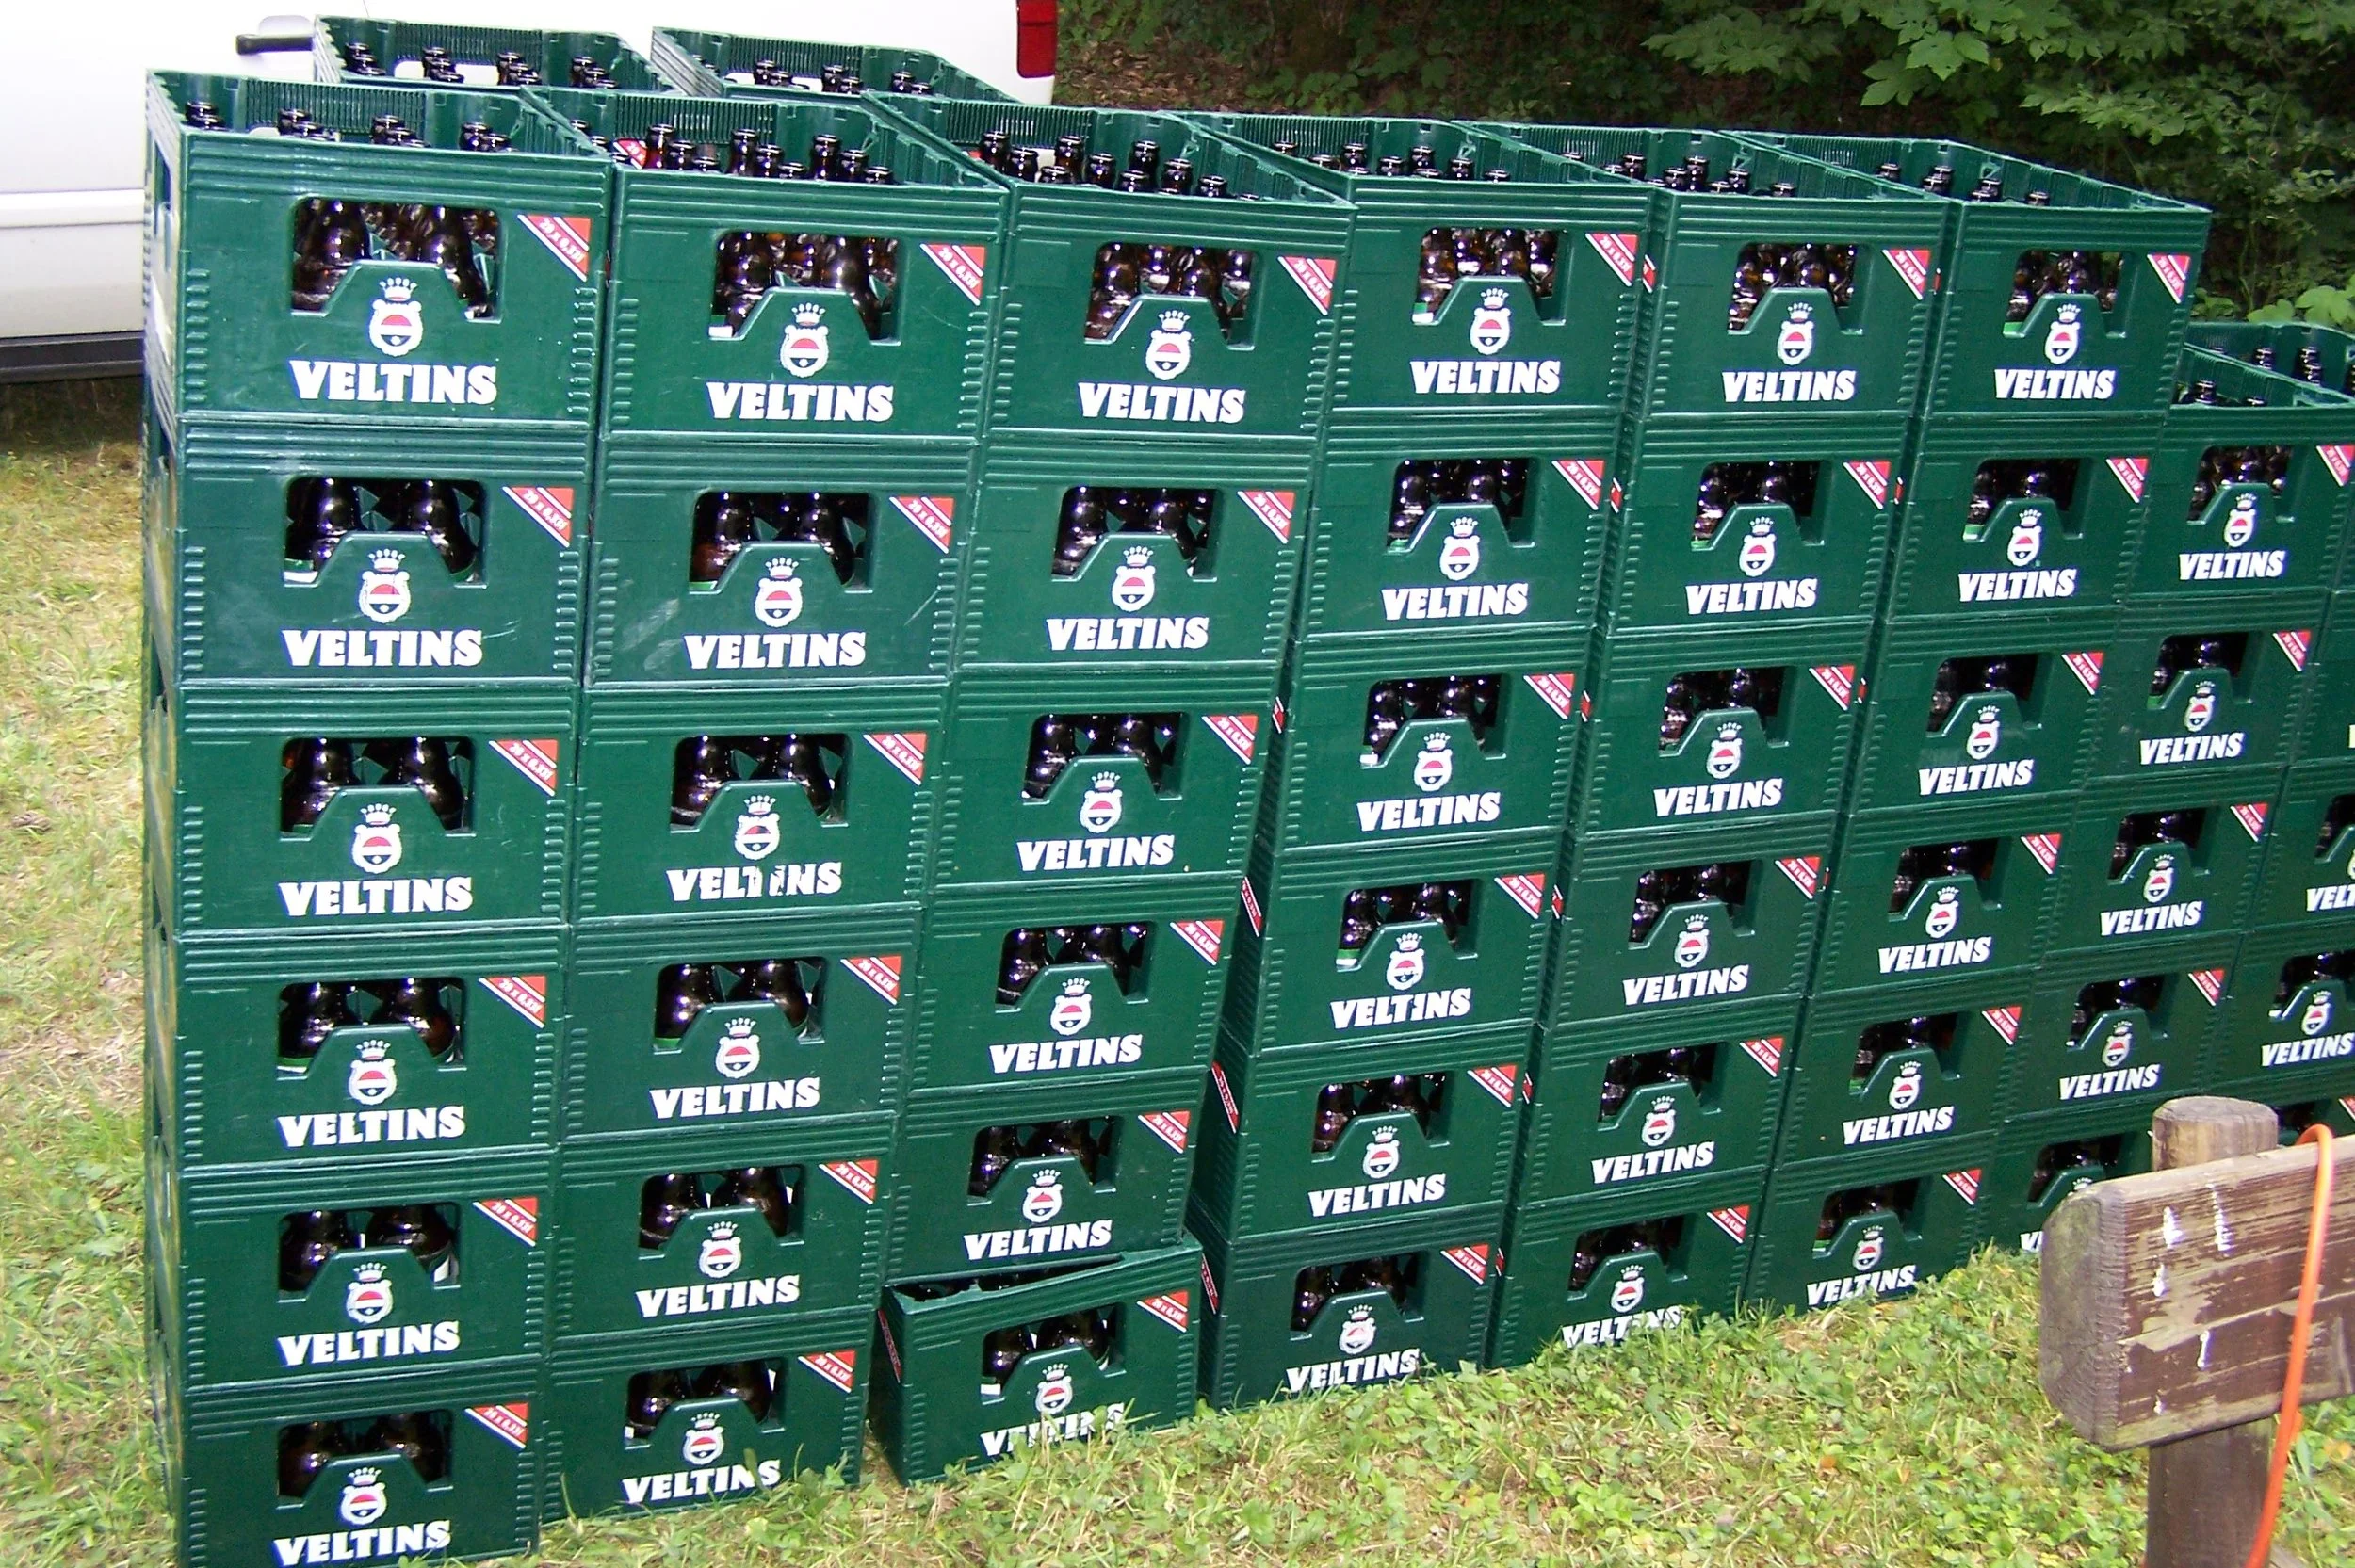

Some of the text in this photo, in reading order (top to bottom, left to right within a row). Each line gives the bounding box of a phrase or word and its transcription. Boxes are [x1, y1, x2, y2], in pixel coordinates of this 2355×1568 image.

[289, 360, 497, 404] VELTINS
[1410, 361, 1560, 393] VELTINS
[1722, 370, 1856, 402] VELTINS
[1995, 369, 2115, 399] VELTINS
[706, 382, 893, 421] VELTINS
[1079, 382, 1245, 423] VELTINS
[2180, 551, 2285, 580] VELTINS
[1382, 583, 1528, 620] VELTINS
[1686, 578, 1817, 614] VELTINS
[1958, 569, 2076, 601] VELTINS
[282, 630, 482, 666] VELTINS
[684, 632, 866, 669] VELTINS
[1047, 617, 1209, 650] VELTINS
[2140, 733, 2244, 764] VELTINS
[1919, 760, 2034, 795] VELTINS
[1356, 792, 1501, 831] VELTINS
[1654, 778, 1782, 816] VELTINS
[1017, 835, 1175, 871] VELTINS
[279, 877, 473, 916] VELTINS
[2101, 901, 2202, 935] VELTINS
[1878, 937, 1991, 973] VELTINS
[1623, 965, 1748, 1005] VELTINS
[1330, 988, 1470, 1028] VELTINS
[990, 1034, 1142, 1075] VELTINS
[2263, 1033, 2355, 1066] VELTINS
[650, 1077, 820, 1123] VELTINS
[2060, 1064, 2160, 1100] VELTINS
[278, 1106, 465, 1147] VELTINS
[1843, 1107, 1954, 1144] VELTINS
[1592, 1141, 1714, 1183] VELTINS
[1308, 1174, 1446, 1217] VELTINS
[964, 1220, 1112, 1260] VELTINS
[636, 1275, 799, 1317] VELTINS
[278, 1321, 460, 1366] VELTINS
[1286, 1348, 1421, 1394] VELTINS
[274, 1520, 450, 1565] VELTINS
